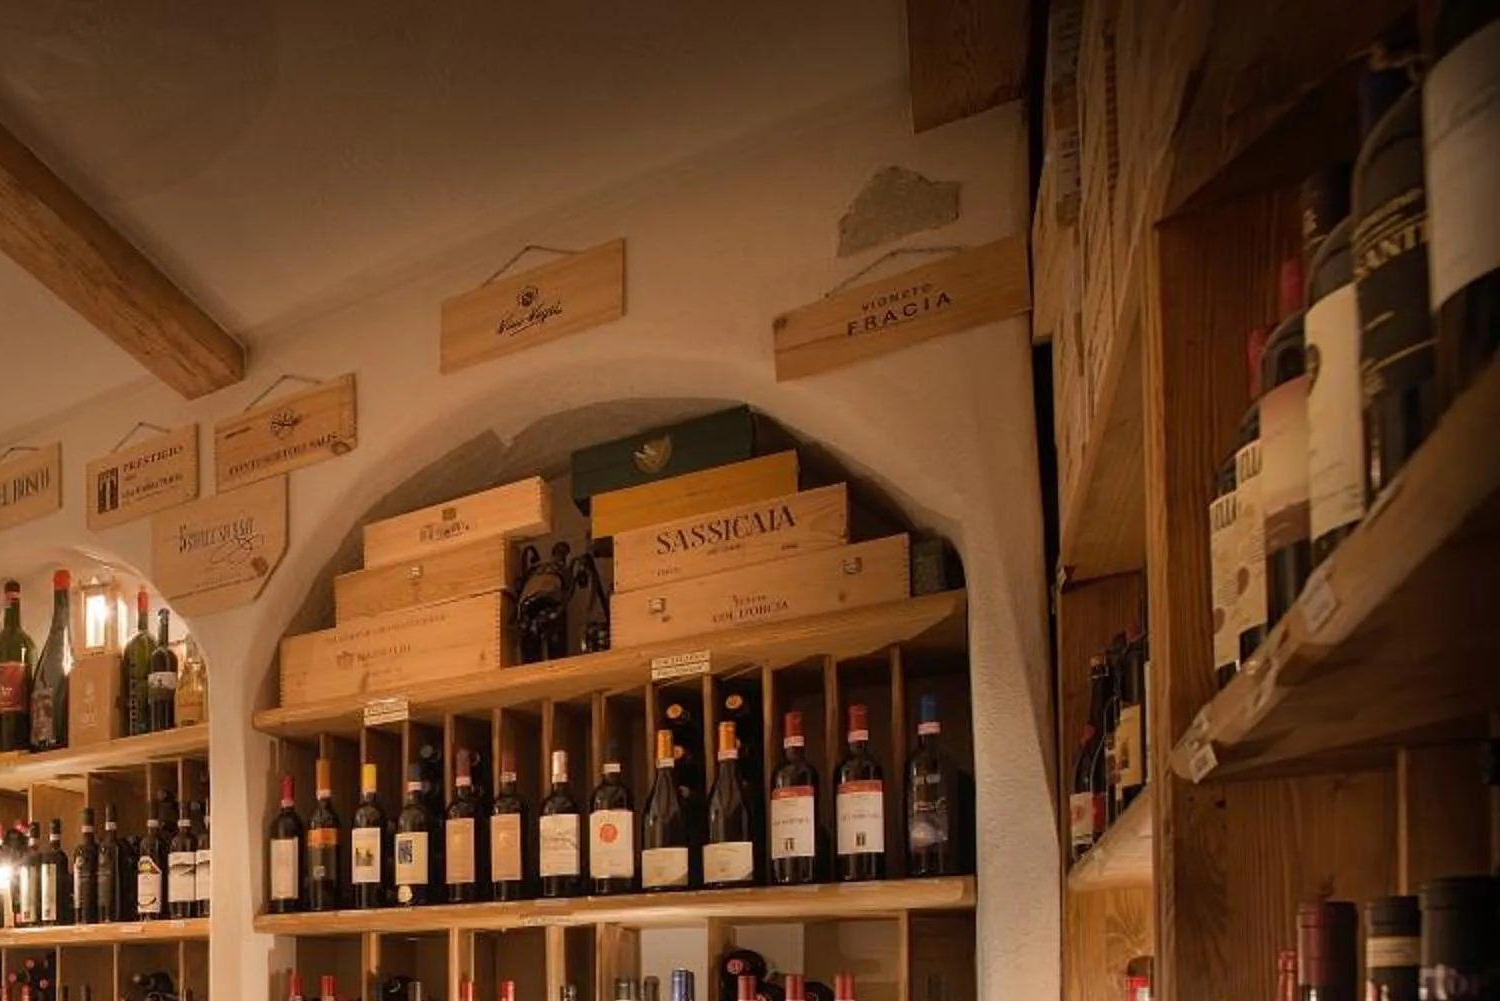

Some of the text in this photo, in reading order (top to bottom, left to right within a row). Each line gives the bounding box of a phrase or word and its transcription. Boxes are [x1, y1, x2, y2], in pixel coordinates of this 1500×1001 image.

[846, 291, 952, 337] FRACIA
[861, 281, 934, 311] VIGNETO
[123, 445, 184, 473] PRESTIGIO
[655, 504, 799, 556] SASSICAIA
